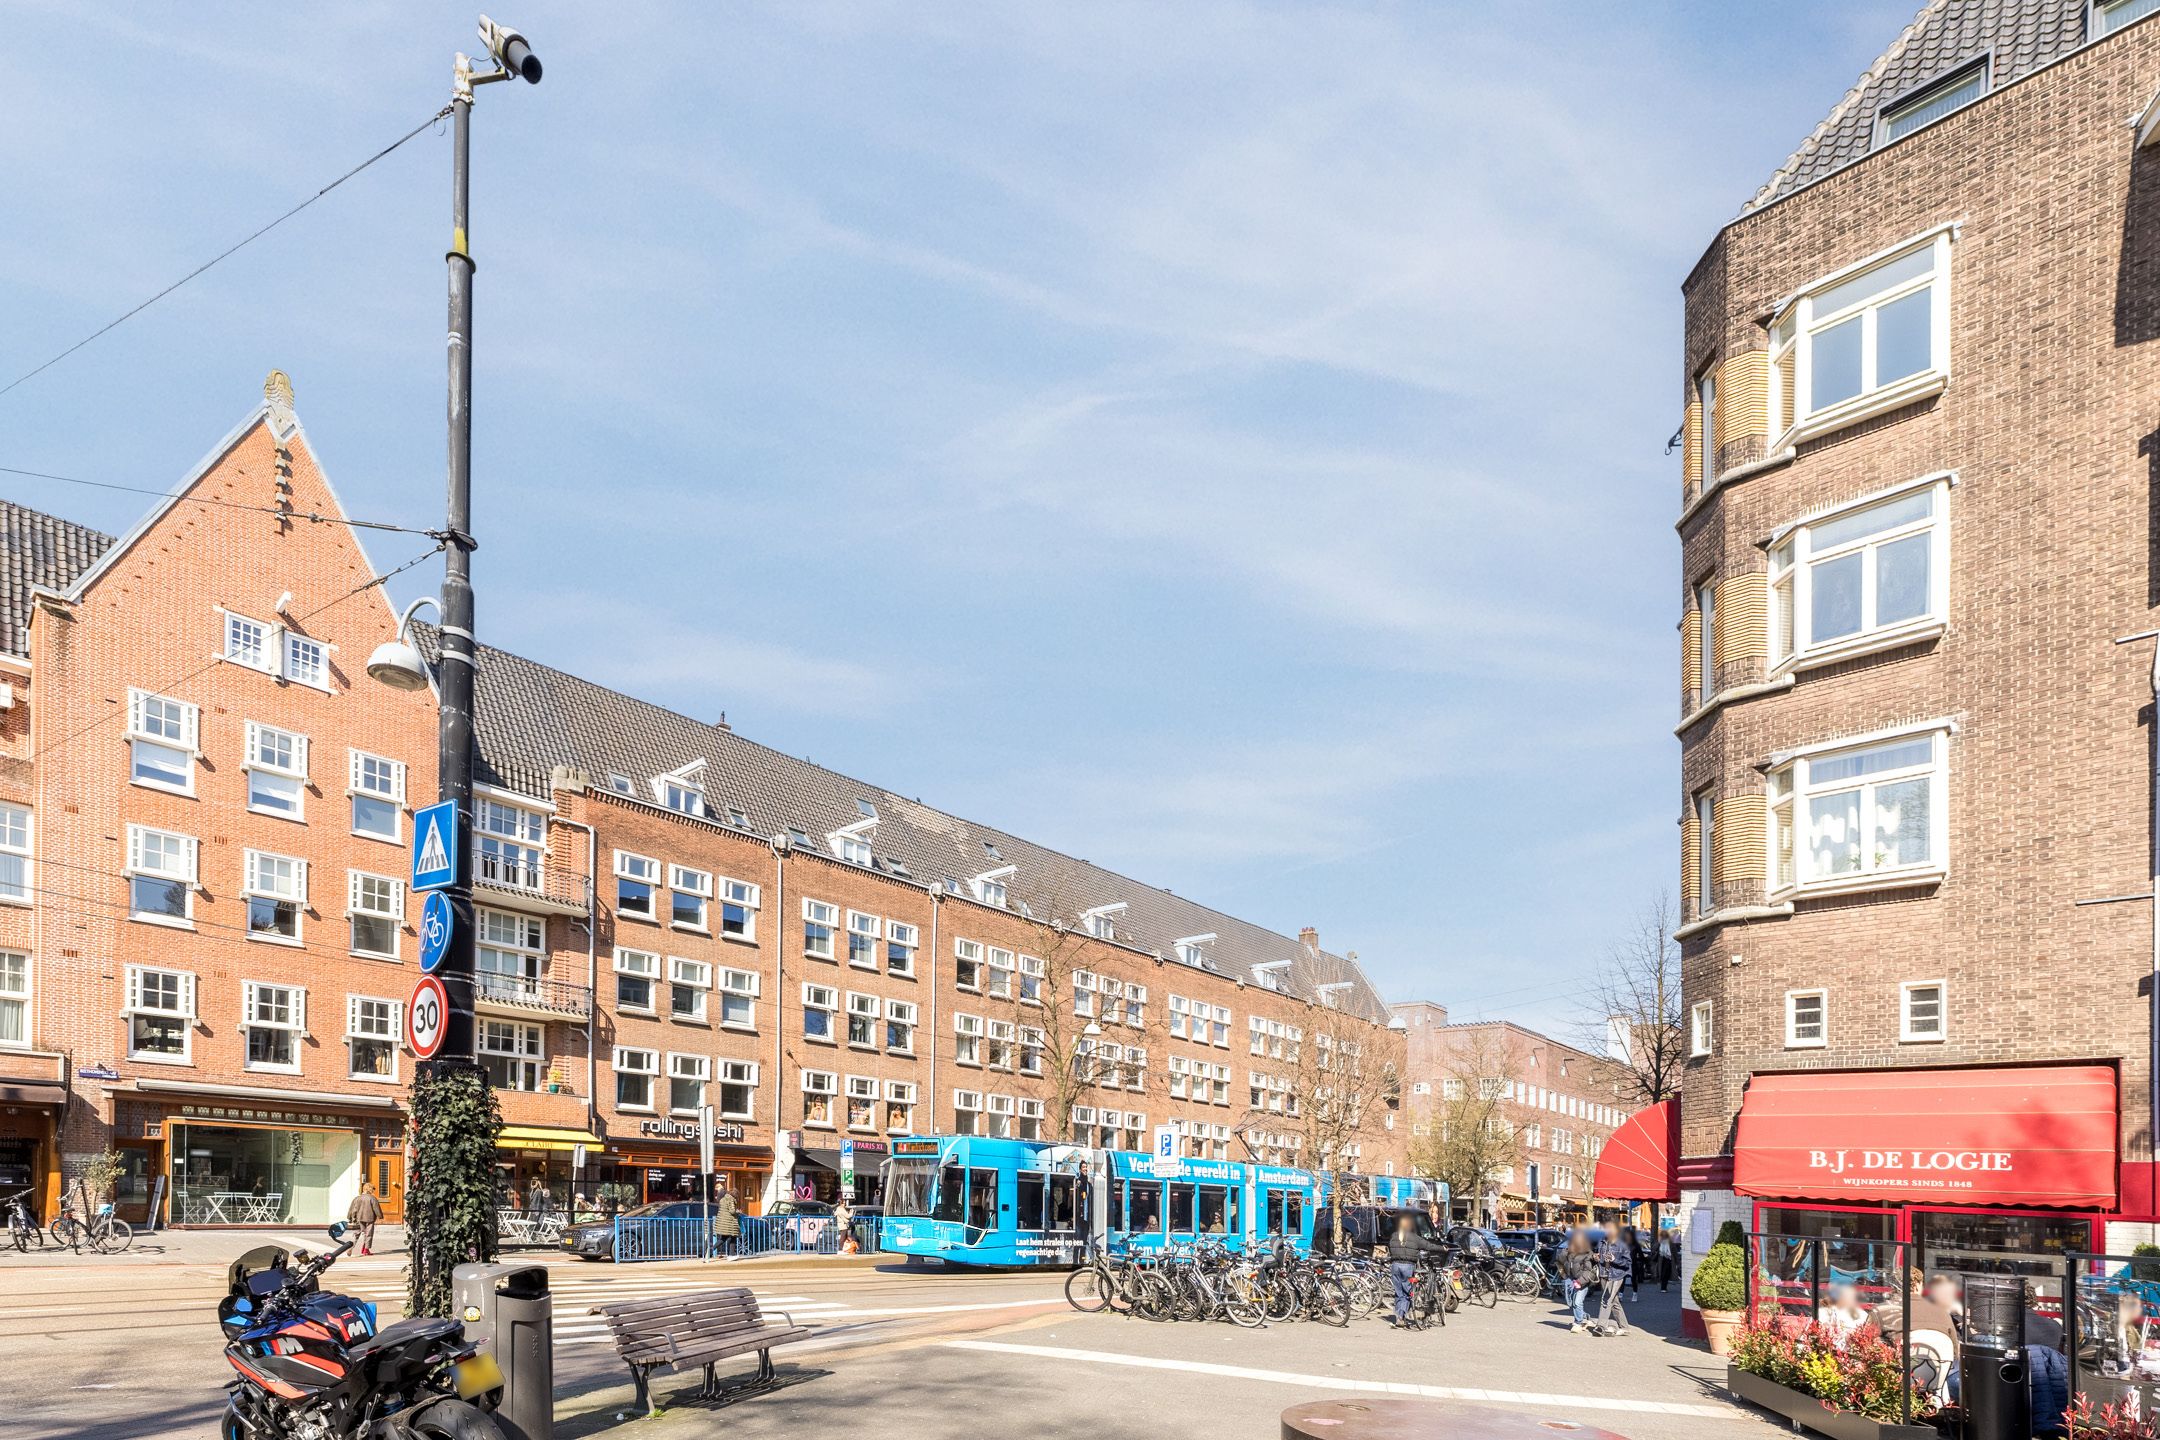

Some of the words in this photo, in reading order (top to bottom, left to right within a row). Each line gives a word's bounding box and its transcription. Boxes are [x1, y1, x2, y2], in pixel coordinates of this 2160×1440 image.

[415, 1001, 438, 1034] 30
[640, 1117, 742, 1139] rollingsshi
[857, 1142, 875, 1150] PARIS
[1162, 1136, 1171, 1147] P
[1809, 1150, 1853, 1174] B.J.
[1862, 1151, 1903, 1169] DE
[1911, 1151, 2013, 1171] LOGIE
[1179, 1160, 1192, 1177] de
[1193, 1164, 1228, 1180] wereld
[1230, 1166, 1241, 1181] in
[1258, 1169, 1310, 1186] Amsterdam
[1843, 1178, 1909, 1187] WIJNKOPERS
[1911, 1179, 1945, 1187] SINDS
[1948, 1180, 1973, 1188] 1848
[1015, 1237, 1030, 1246] Laat
[1030, 1237, 1043, 1246] hem
[1043, 1237, 1064, 1246] stralen
[1065, 1239, 1073, 1248] op
[1015, 1247, 1055, 1258] regenachtige
[1055, 1247, 1066, 1258] dag
[1155, 1244, 1191, 1257] wrken
